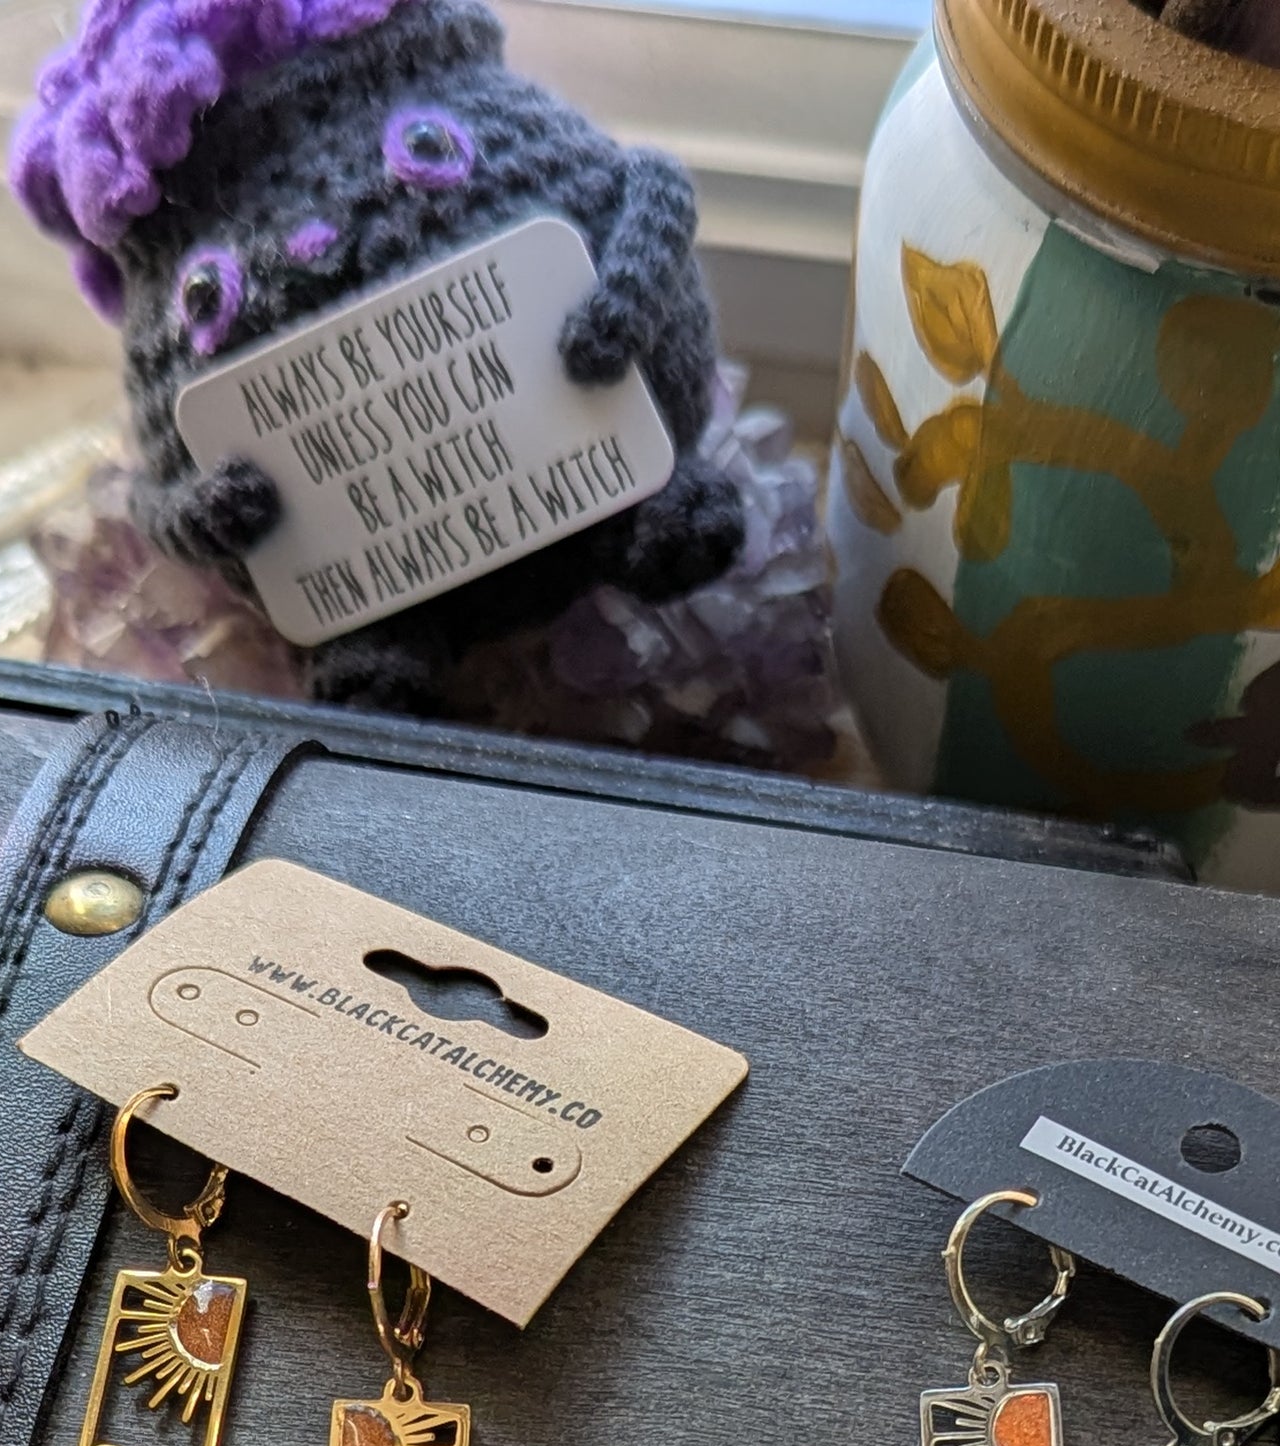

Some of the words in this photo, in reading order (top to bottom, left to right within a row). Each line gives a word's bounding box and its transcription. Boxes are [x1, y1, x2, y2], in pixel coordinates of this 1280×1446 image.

[240, 345, 345, 438] ALWAYS
[339, 326, 384, 390] BE
[375, 262, 513, 370] YOURSELF
[290, 399, 394, 486] UNLESS
[384, 370, 451, 442] YOU
[448, 340, 516, 414] CAN
[296, 558, 369, 626] THEN
[365, 514, 470, 603] ALWAYS
[464, 497, 511, 558] BE
[508, 484, 539, 541] A
[529, 435, 637, 526] WITCH
[347, 477, 393, 535] BE
[388, 466, 419, 522] A
[407, 418, 514, 508] WITCH
[246, 955, 603, 1131] WWW.BLACKCATALCHEMY.CO
